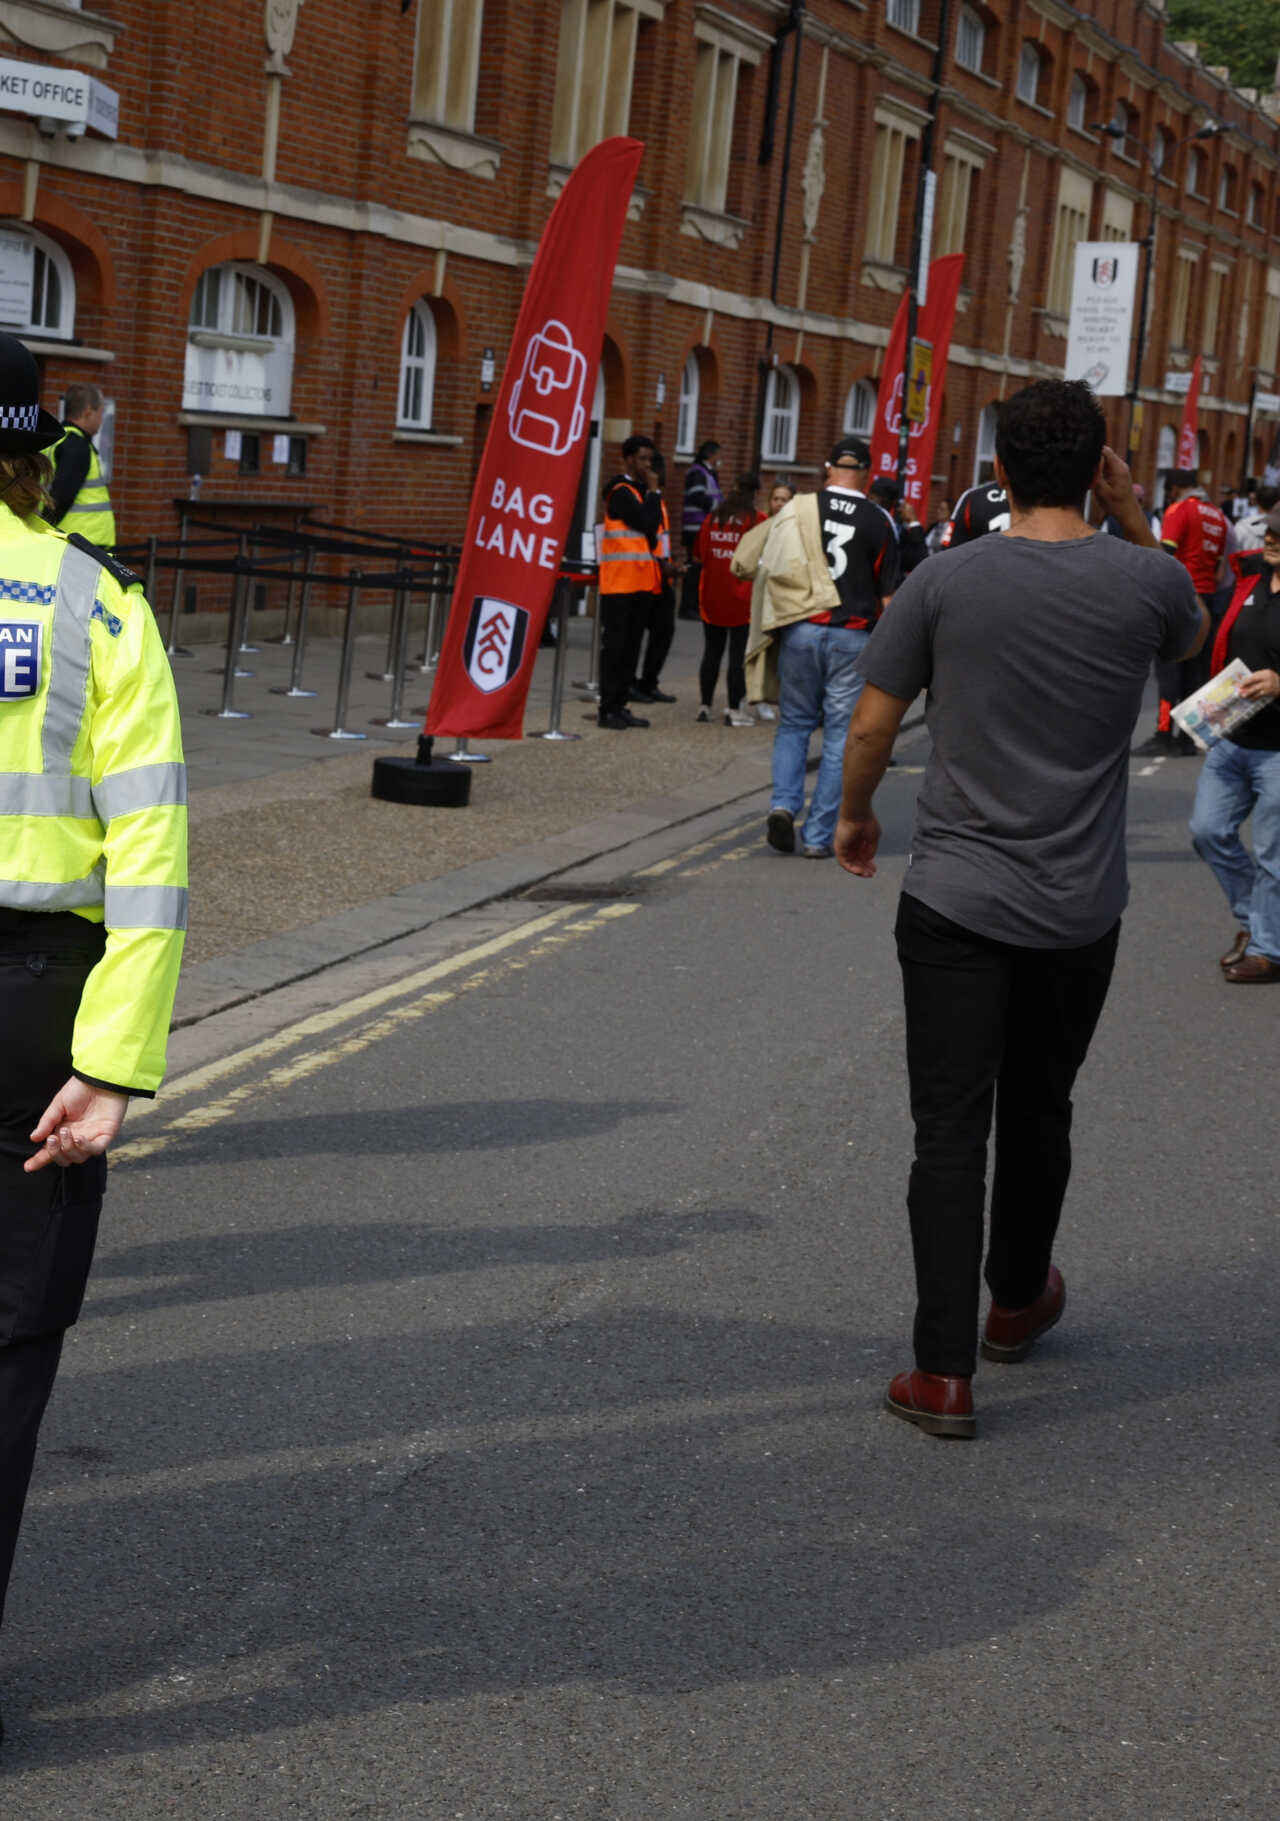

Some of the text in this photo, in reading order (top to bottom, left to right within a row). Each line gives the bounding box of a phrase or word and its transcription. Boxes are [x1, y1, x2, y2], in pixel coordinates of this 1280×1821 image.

[33, 81, 83, 106] OFFICE
[880, 453, 917, 475] BG
[490, 477, 553, 525] BAG
[829, 498, 856, 515] STU
[475, 515, 558, 569] LANE
[823, 519, 855, 581] 3
